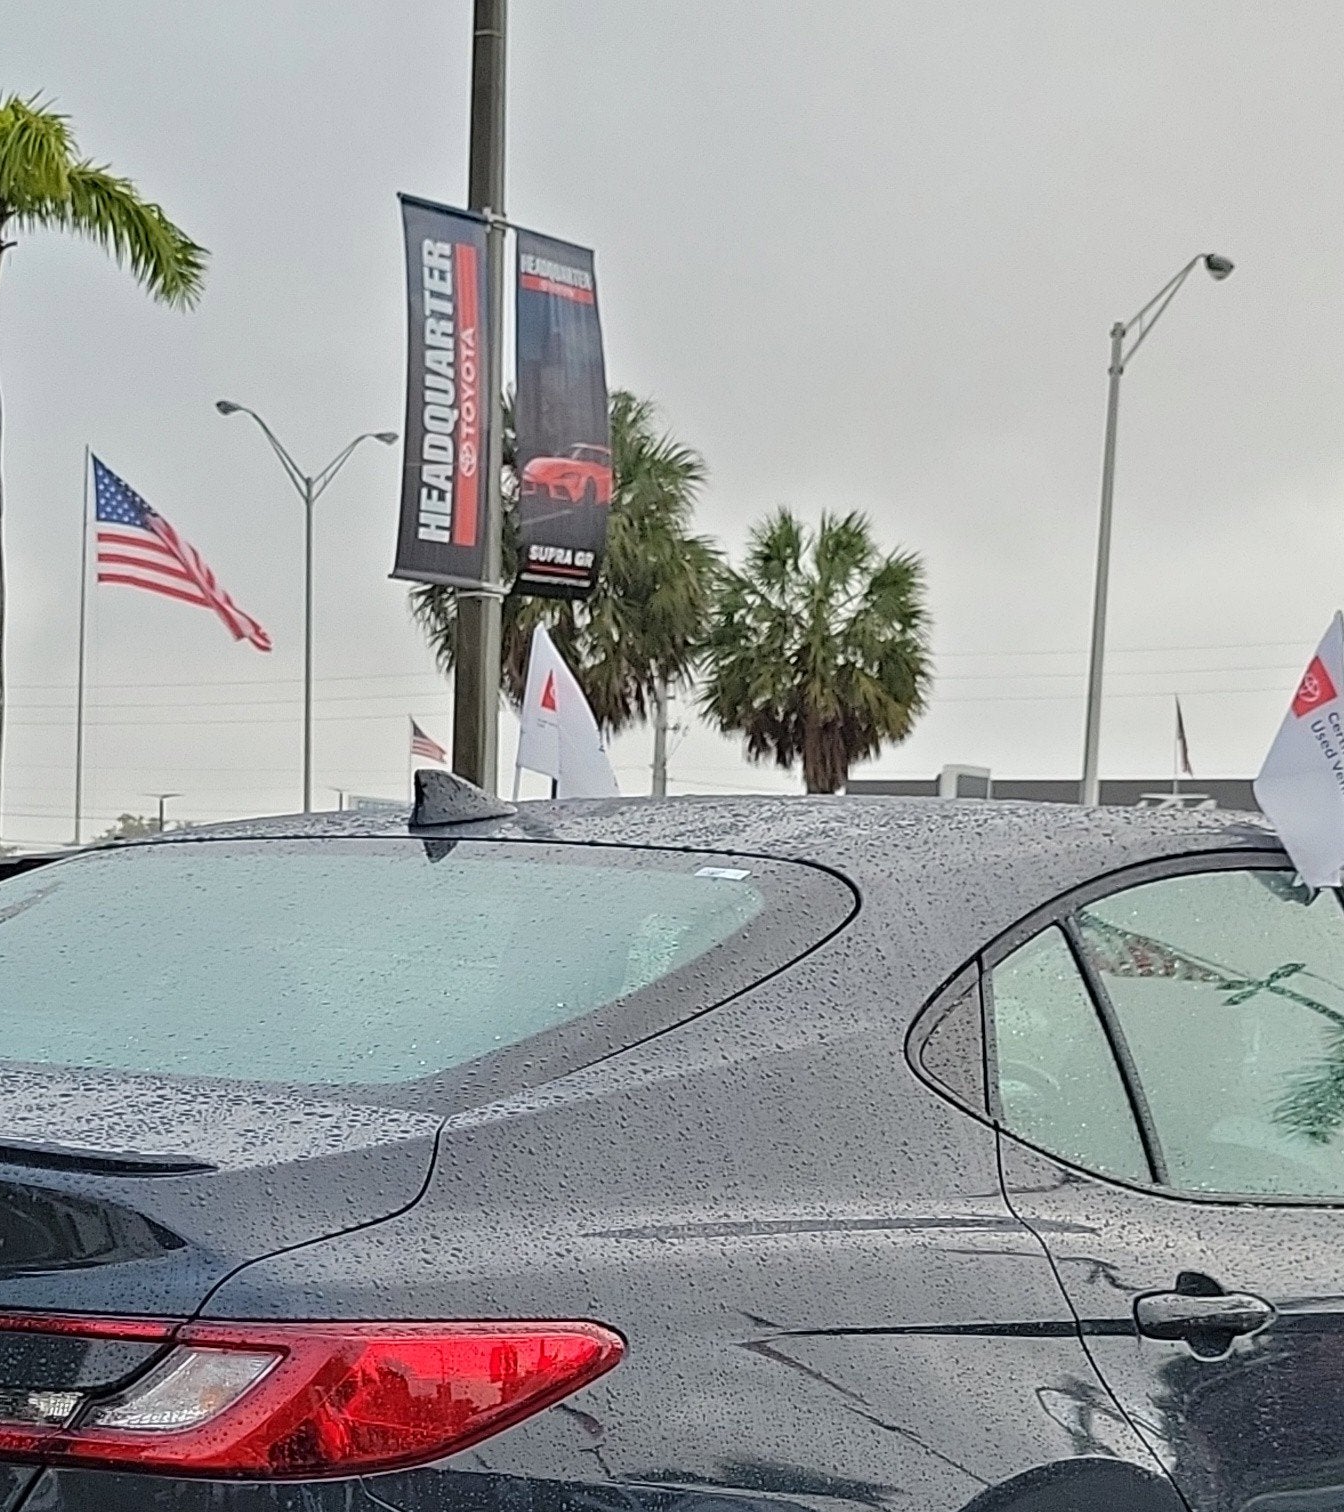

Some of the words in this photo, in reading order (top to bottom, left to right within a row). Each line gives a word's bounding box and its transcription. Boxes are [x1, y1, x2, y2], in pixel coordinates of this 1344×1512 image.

[418, 238, 459, 543] HEADQUARTER
[460, 328, 477, 441] TOYOTA
[529, 544, 573, 565] SUPRA
[1310, 719, 1338, 760] Used
